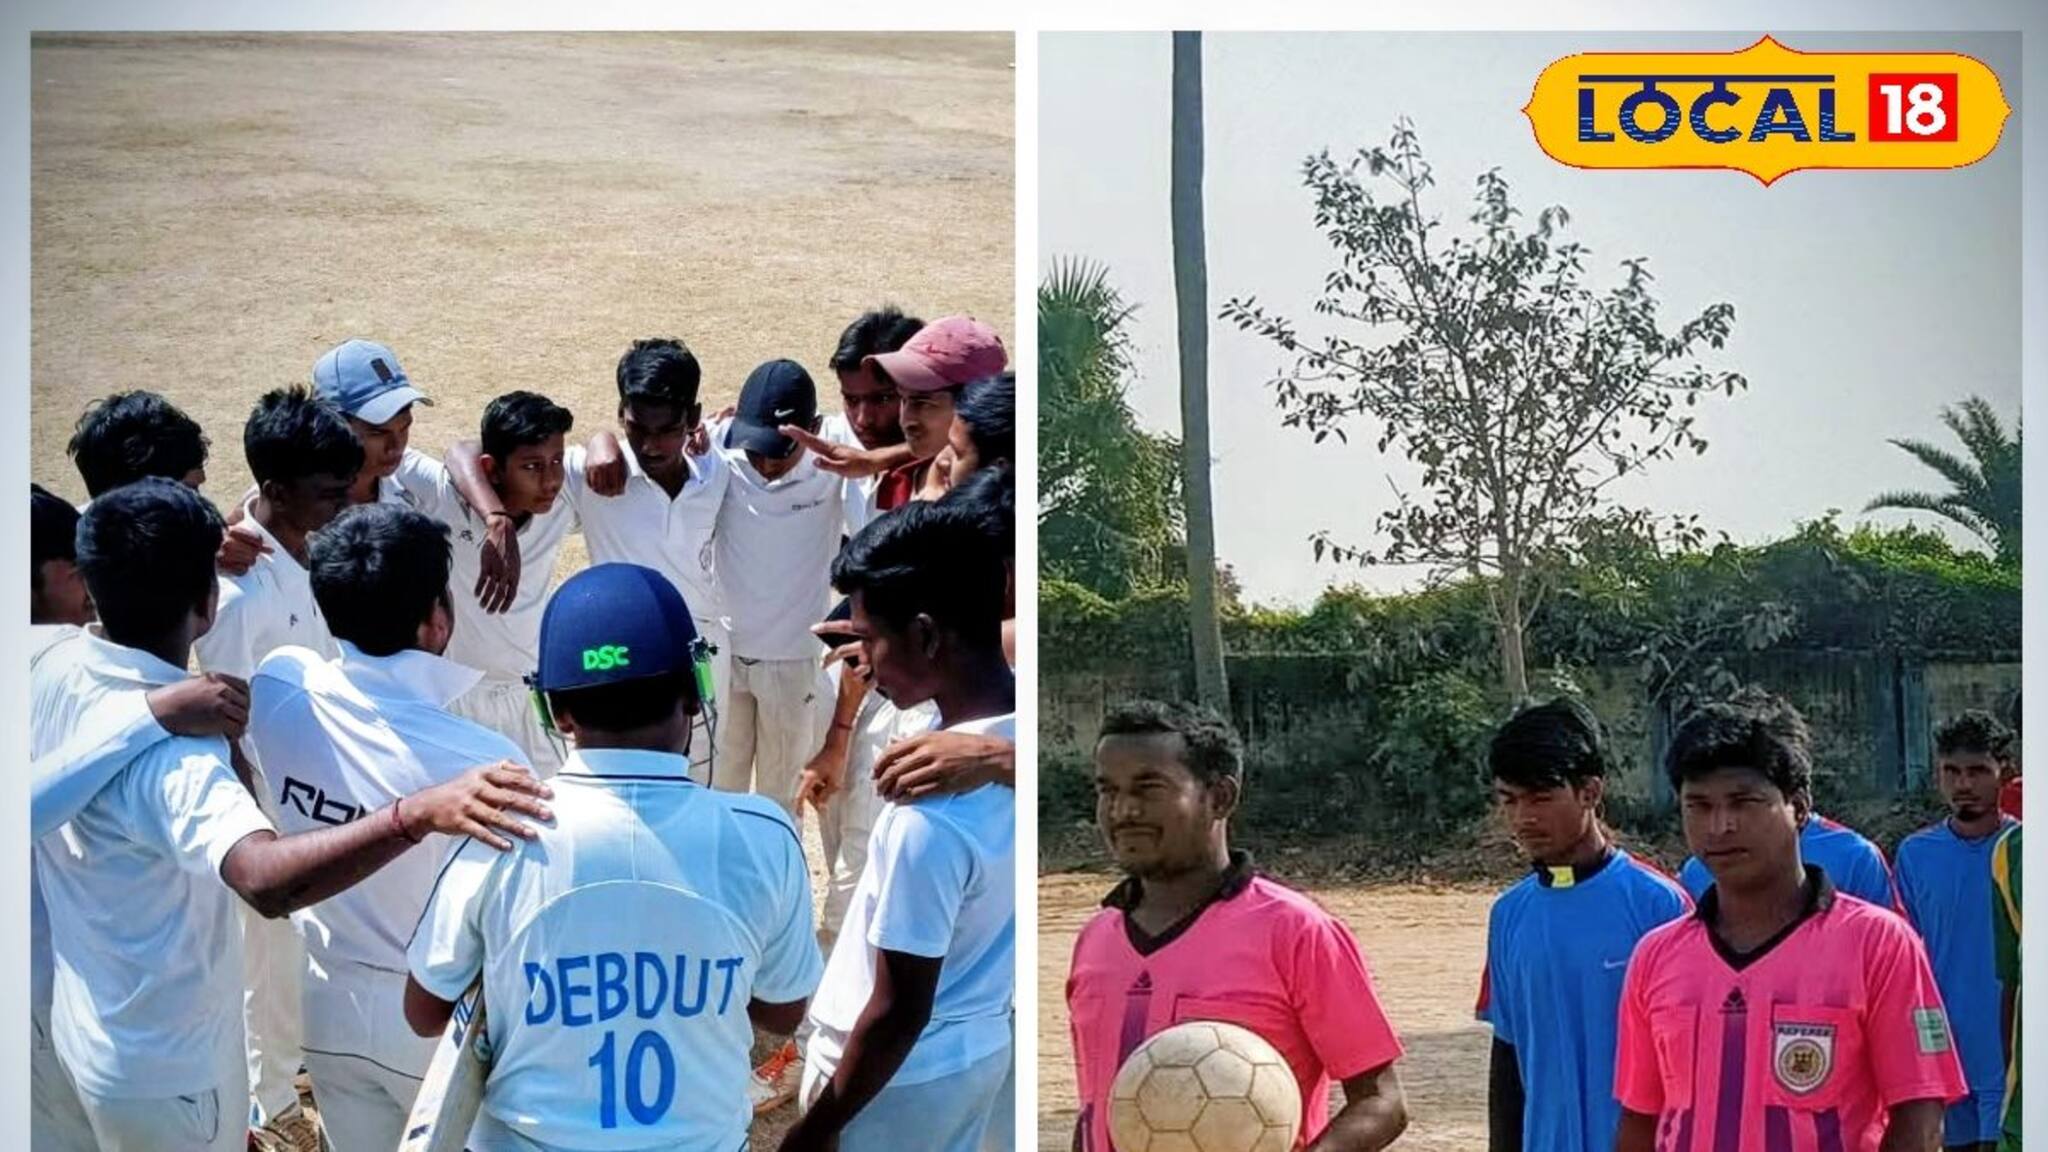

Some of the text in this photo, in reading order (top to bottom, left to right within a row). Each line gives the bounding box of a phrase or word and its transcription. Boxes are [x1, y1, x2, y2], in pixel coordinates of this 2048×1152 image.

[583, 645, 630, 670] DSC
[280, 776, 366, 826] Rb
[523, 952, 744, 1027] DEBDUT
[588, 1030, 677, 1129] 10
